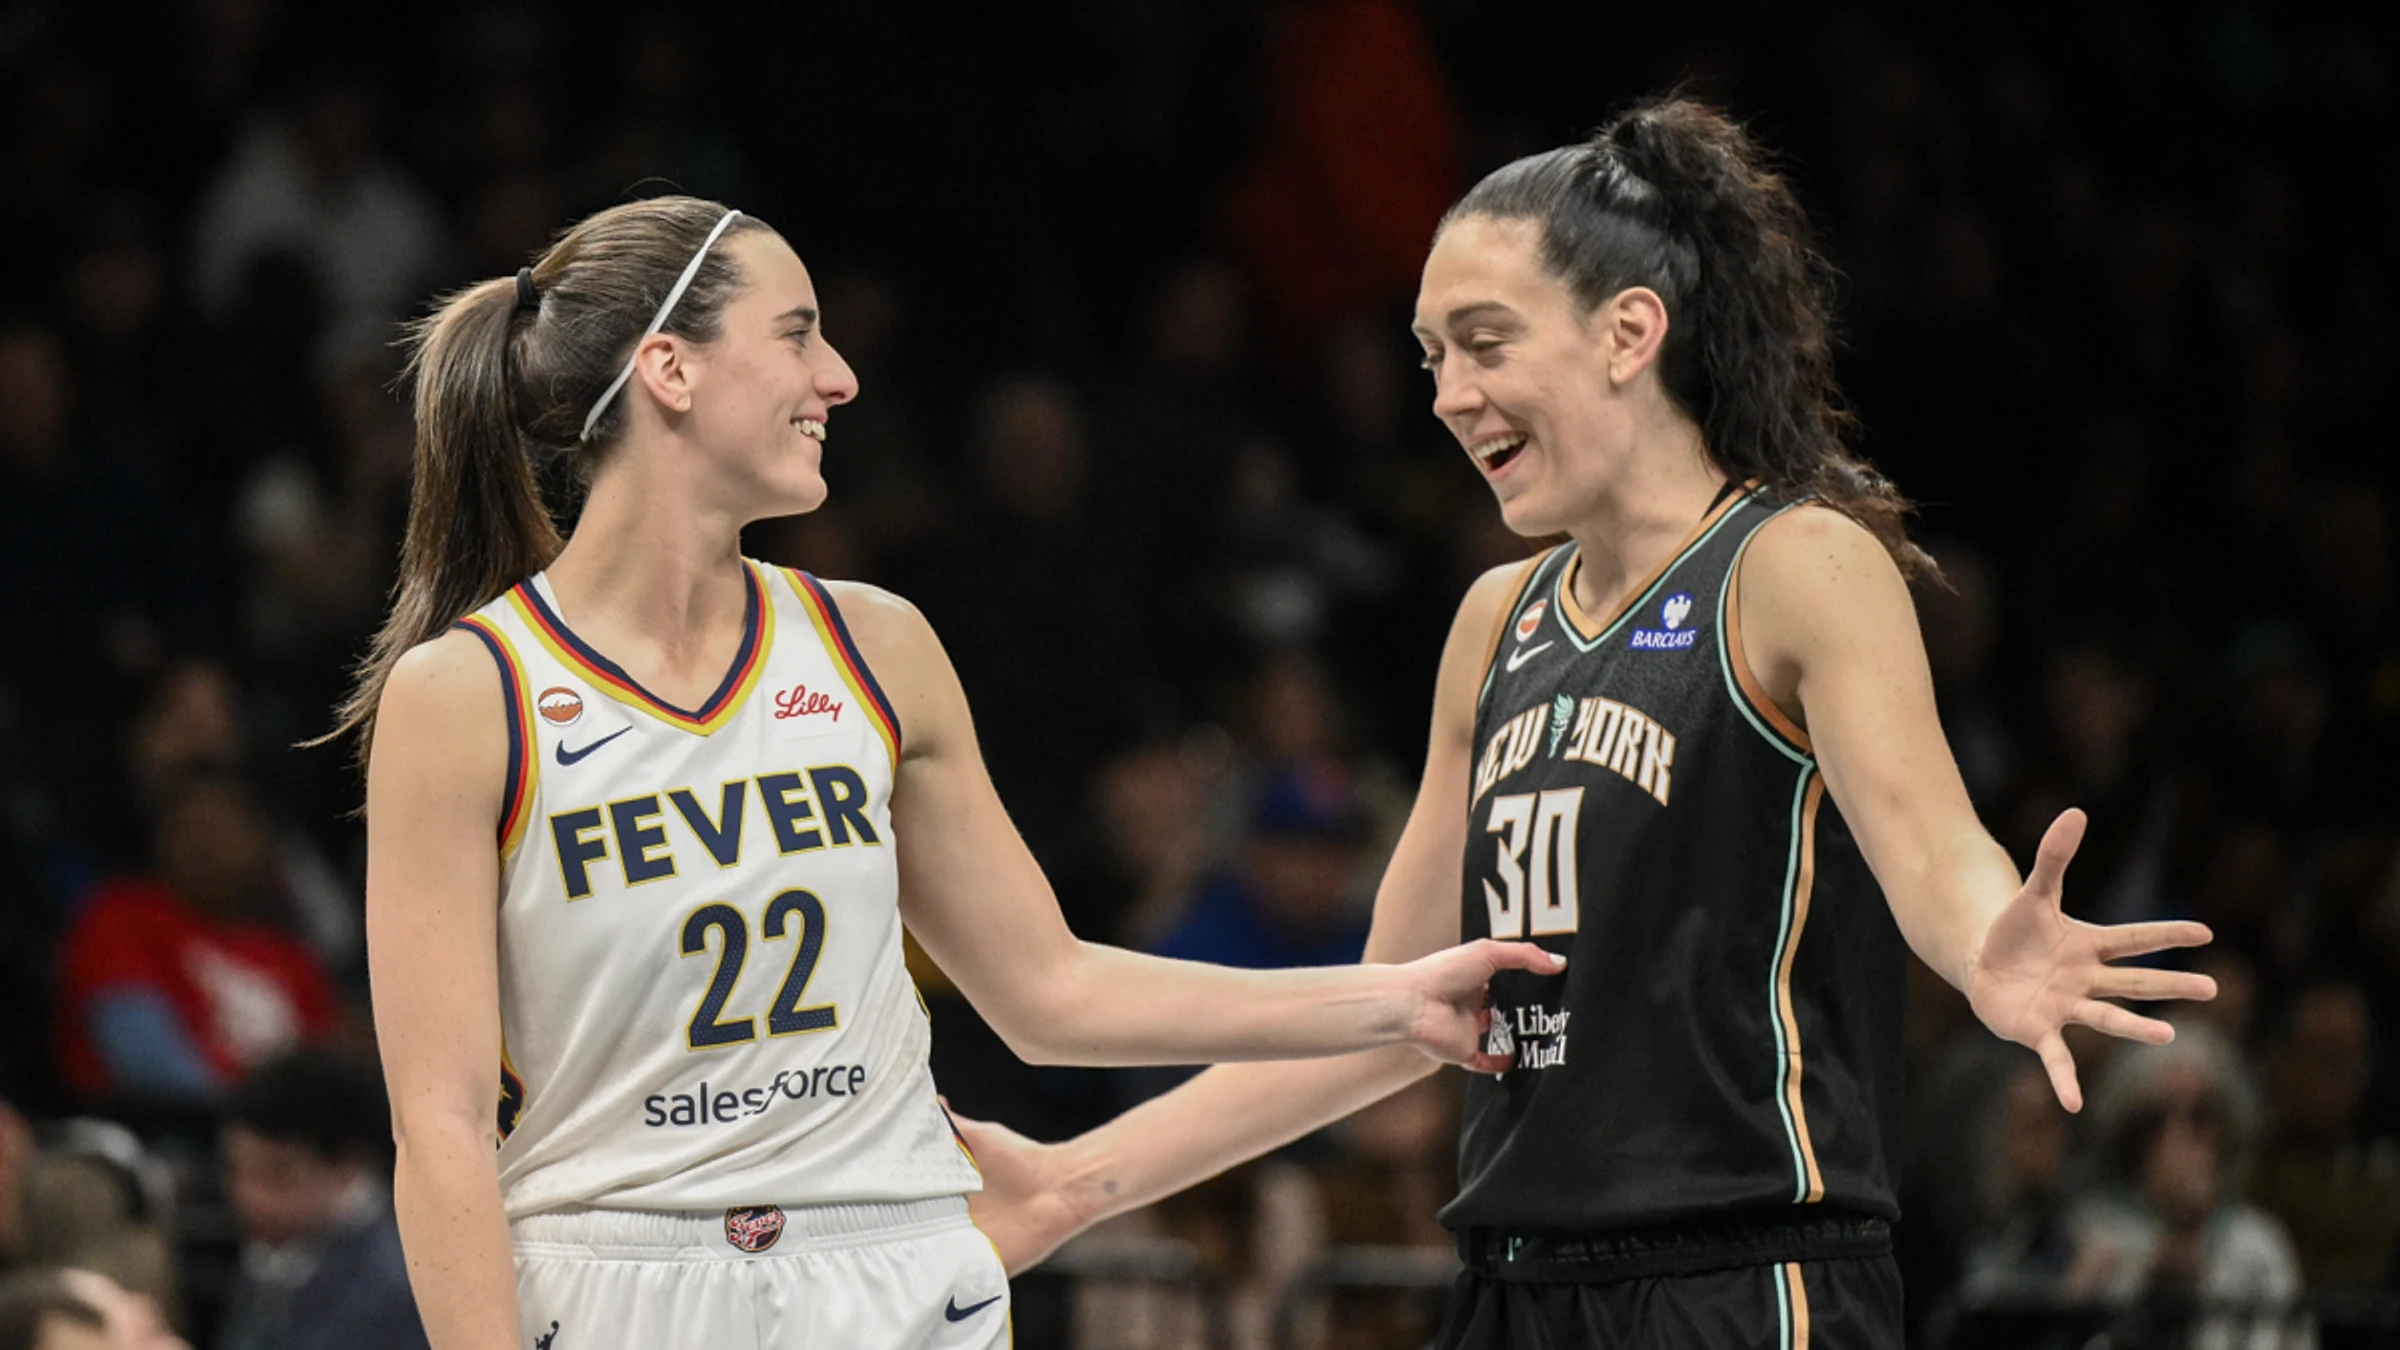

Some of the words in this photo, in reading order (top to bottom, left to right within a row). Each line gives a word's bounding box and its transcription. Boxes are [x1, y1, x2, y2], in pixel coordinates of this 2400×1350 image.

[1632, 629, 1696, 648] BARCLAYS
[774, 684, 843, 722] Lilly
[1470, 703, 1550, 815] NEW
[1563, 696, 1681, 807] YORK
[547, 764, 882, 902] FEVER
[1482, 786, 1585, 940] 30
[679, 886, 840, 1052] 22
[1516, 1004, 1571, 1036] Libey
[645, 1065, 865, 1127] salesforce
